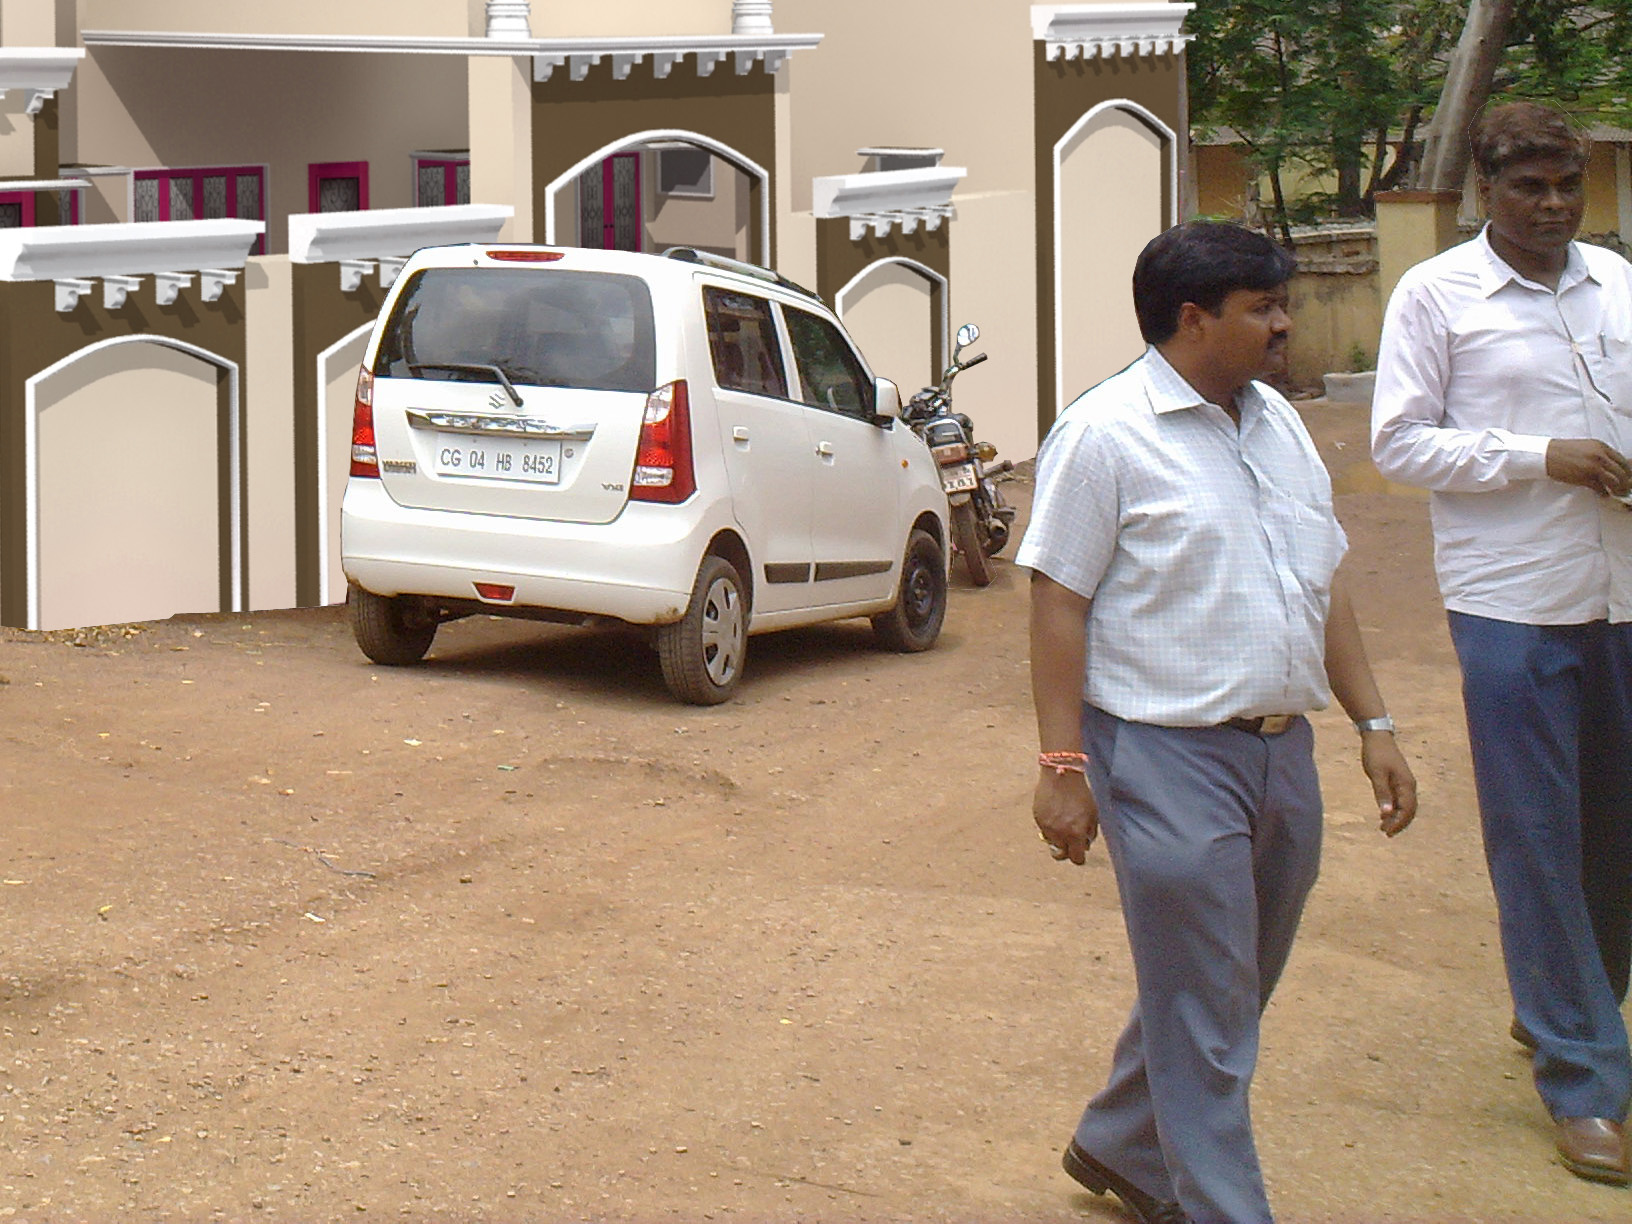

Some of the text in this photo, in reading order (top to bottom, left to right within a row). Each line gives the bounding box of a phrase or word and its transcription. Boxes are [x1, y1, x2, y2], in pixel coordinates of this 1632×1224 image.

[440, 448, 553, 474] CG 04 HB 8452
